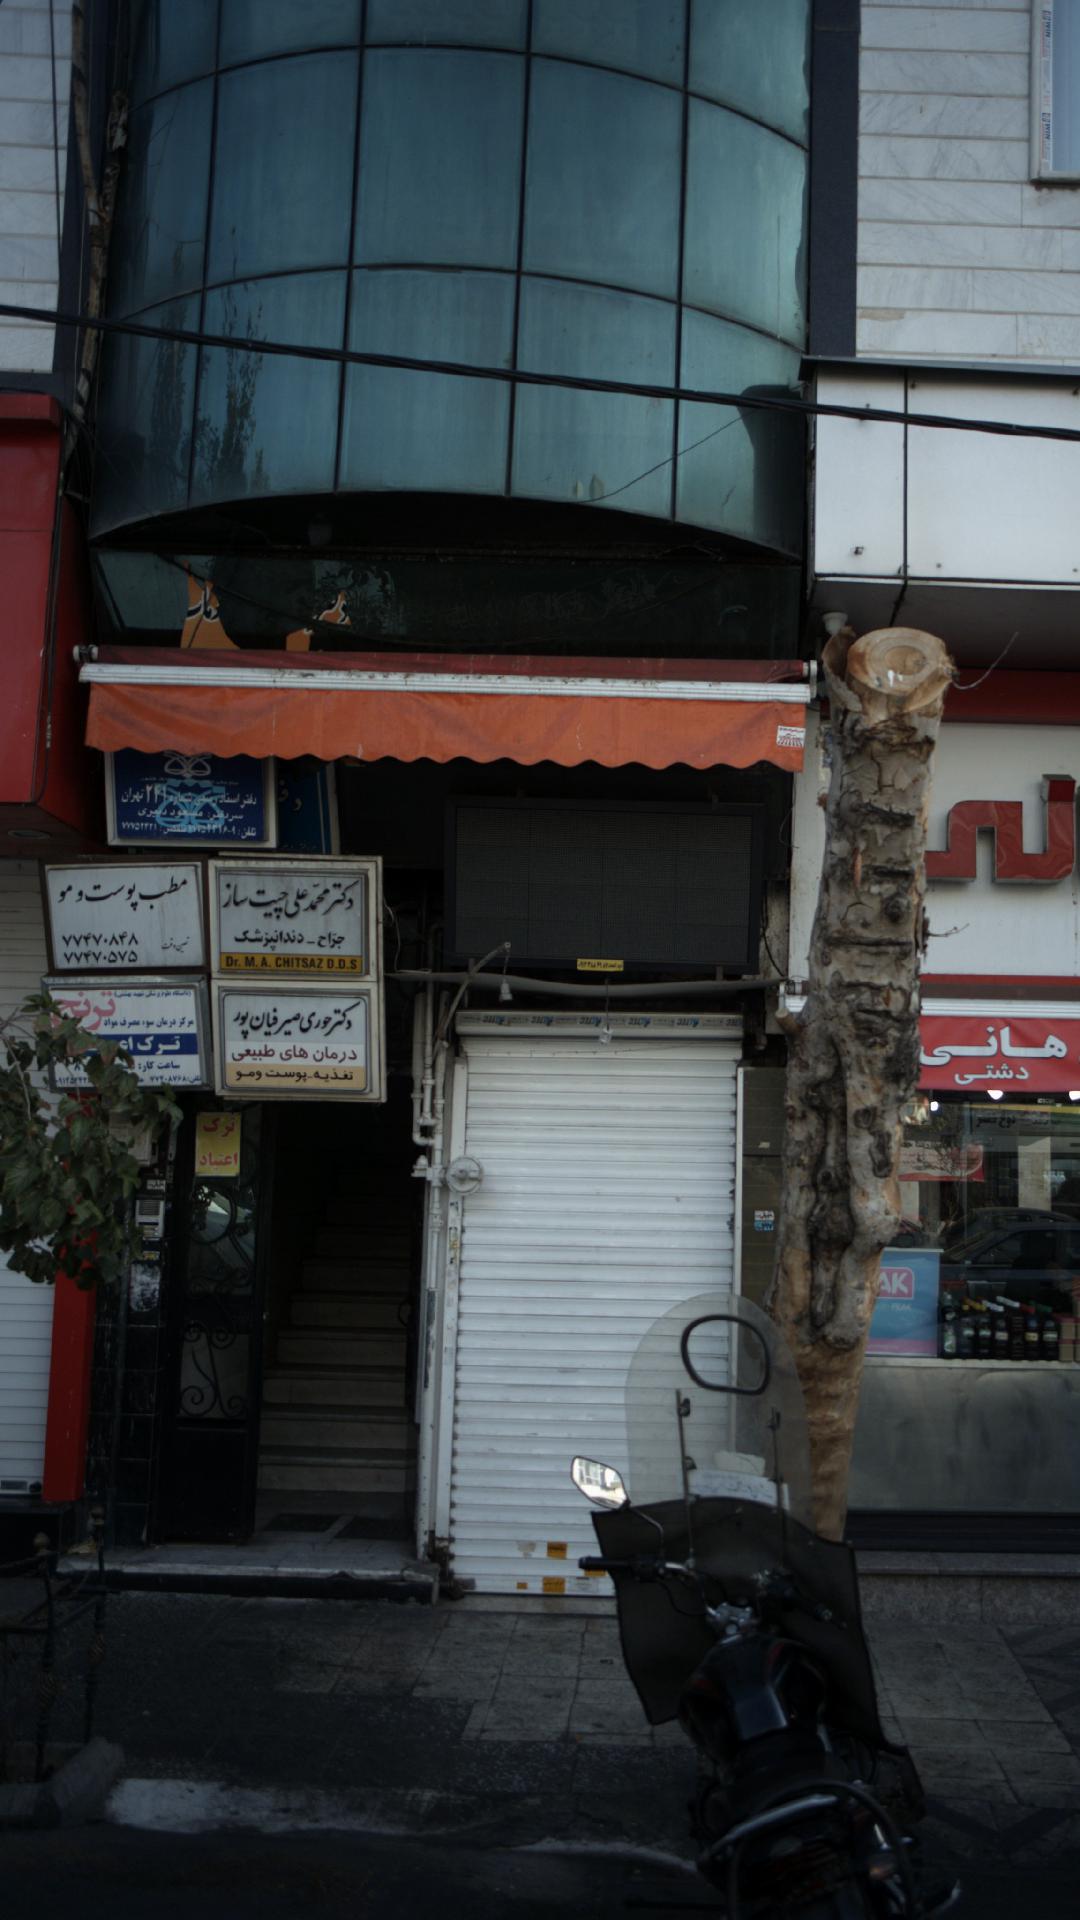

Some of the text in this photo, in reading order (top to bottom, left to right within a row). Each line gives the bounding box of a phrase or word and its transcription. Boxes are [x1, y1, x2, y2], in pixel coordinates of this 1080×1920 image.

[121, 786, 145, 803] تهران
[240, 792, 257, 808] دفتر
[58, 876, 187, 911] مطب پوست و مو
[223, 883, 249, 908] ساز
[284, 888, 308, 918] علی
[322, 880, 360, 916] دکتر
[249, 891, 288, 919] چیت
[63, 931, 138, 946] ۷۷۴۷۰۸۴۸
[234, 929, 304, 951] دندانپزشک
[64, 949, 138, 963] ۷۷۴۷۰۵۷۵
[225, 955, 241, 968] Dr.
[244, 956, 259, 968] M.
[260, 956, 271, 968] A.
[275, 957, 324, 969] CHITSAZ
[103, 1018, 119, 1028] مواد
[157, 1017, 177, 1029] درمان
[177, 1017, 195, 1028] مرکز
[233, 1012, 249, 1039] پور
[299, 1012, 332, 1034] حوری
[324, 1001, 360, 1037] دکتر
[137, 1035, 182, 1055] ترک
[232, 1044, 358, 1063] درمان های طبیعی
[919, 1026, 1068, 1067] هانی
[157, 1061, 181, 1070] ساعت
[954, 1063, 1029, 1085] دشتی
[203, 1115, 236, 1138] ترک
[199, 1151, 239, 1170] اعتیاد
